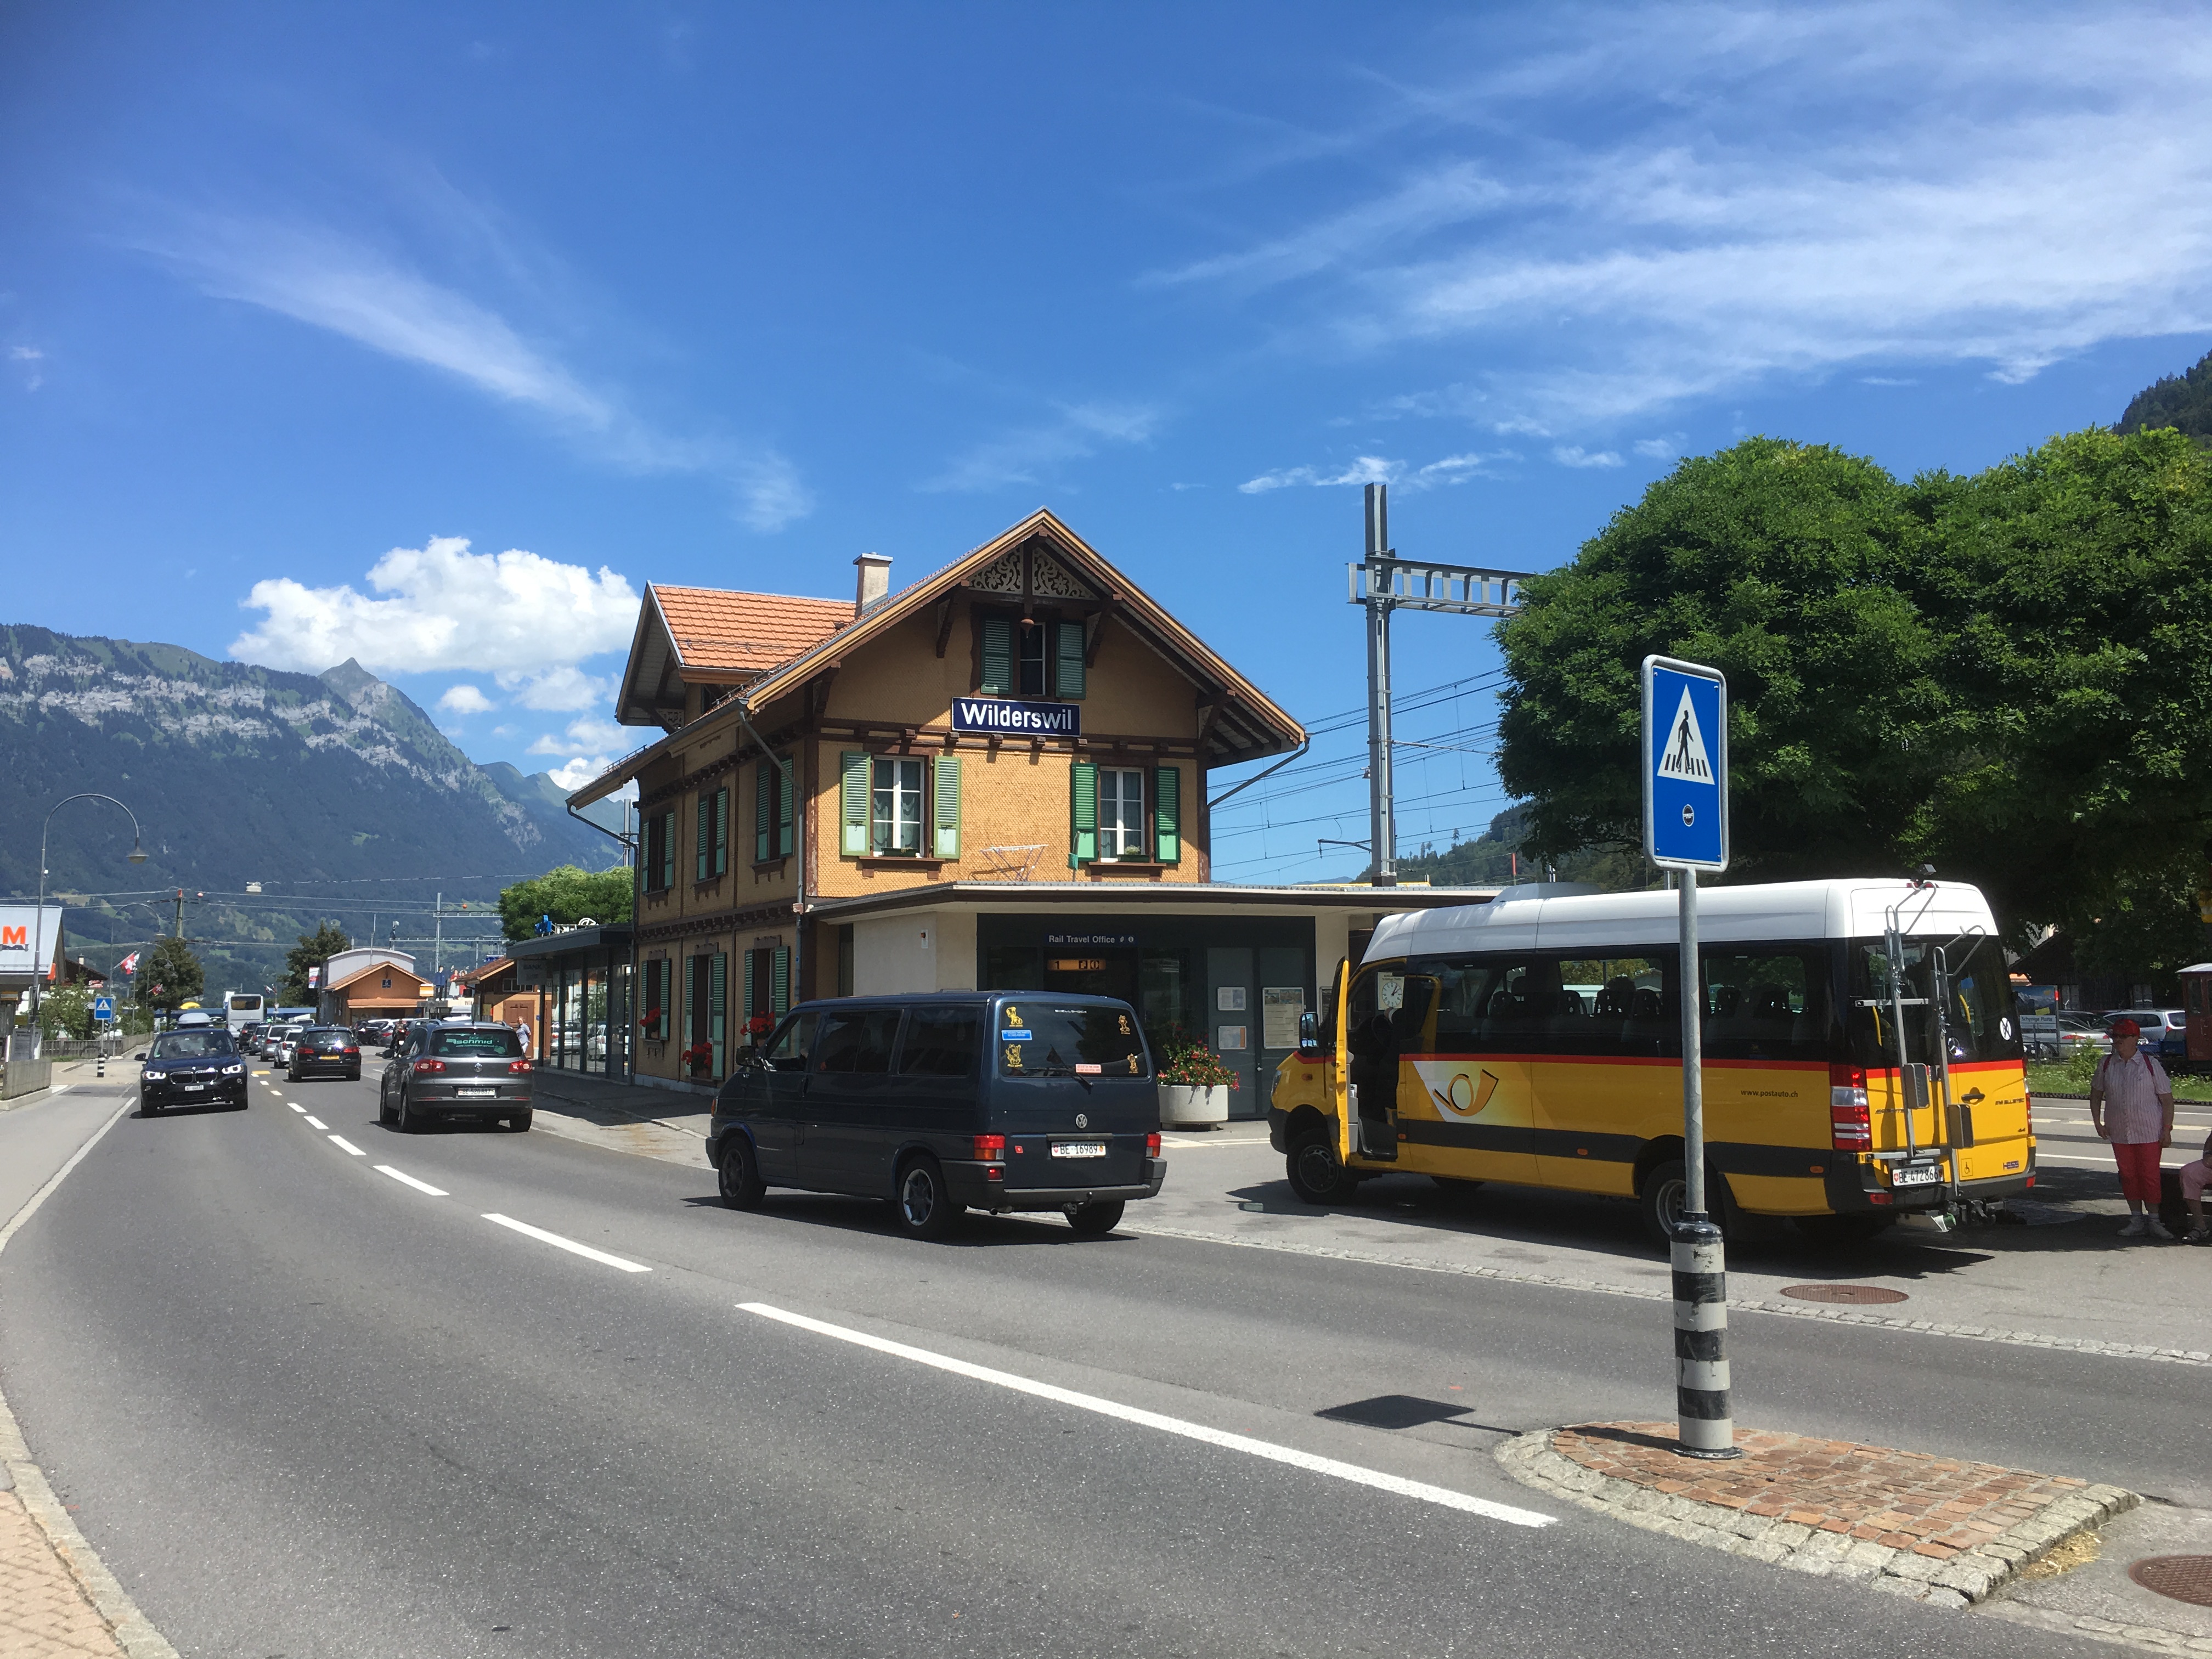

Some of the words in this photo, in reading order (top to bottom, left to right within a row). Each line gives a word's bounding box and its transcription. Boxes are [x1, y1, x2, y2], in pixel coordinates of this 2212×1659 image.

[961, 703, 1071, 730] Wilderswil
[2, 926, 26, 944] M
[1060, 1144, 1070, 1154] BE
[1075, 1143, 1097, 1154] 16989
